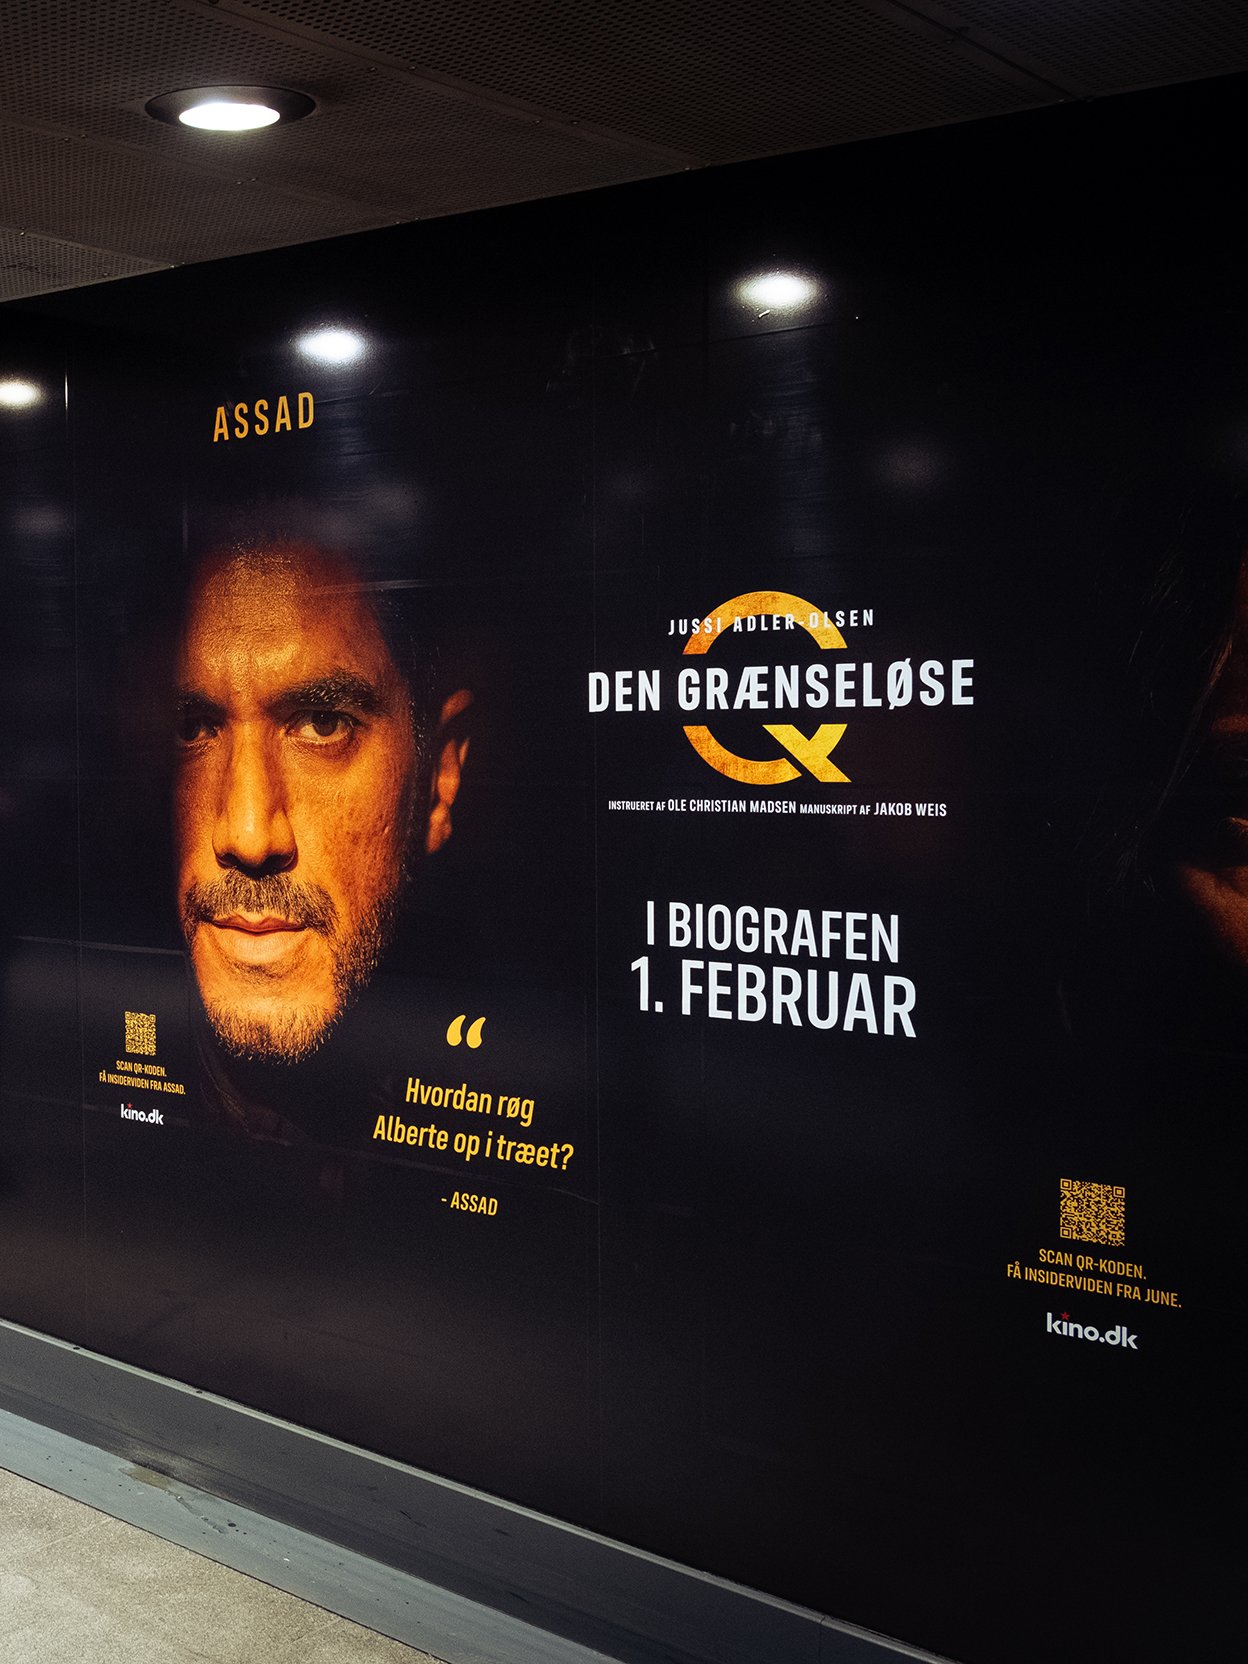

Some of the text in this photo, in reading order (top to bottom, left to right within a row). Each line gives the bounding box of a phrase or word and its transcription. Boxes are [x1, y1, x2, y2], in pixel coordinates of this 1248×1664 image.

[213, 392, 314, 442] ASSAD
[668, 608, 874, 636] JUSSI ADLER-OLSEN
[588, 658, 975, 712] DEN GRÆNSELØSE
[608, 799, 947, 817] INSTRUERET AF OLE CHRISTIAN MADSEN MANUSKRIPT AF JAKOB WEIS
[647, 900, 899, 963] I BIOGRAFEN
[631, 956, 917, 1038] 1. FEBRUAR
[99, 1069, 186, 1095] FÅ INSIDERVIDEN FRA ASSAD.
[116, 1060, 167, 1077] SCAN QR-KODEN.
[120, 1103, 164, 1126] kino.dk
[405, 1077, 535, 1128] Hvordan røg
[372, 1115, 575, 1171] Alberte op i træet?
[450, 1191, 499, 1217] ASSAD
[1039, 1248, 1147, 1281] SCAN QR-KODEN.
[1007, 1260, 1182, 1309] FÅ INSIDERVIDEN FRA JUNE.
[1046, 1311, 1139, 1350] kino.dk
